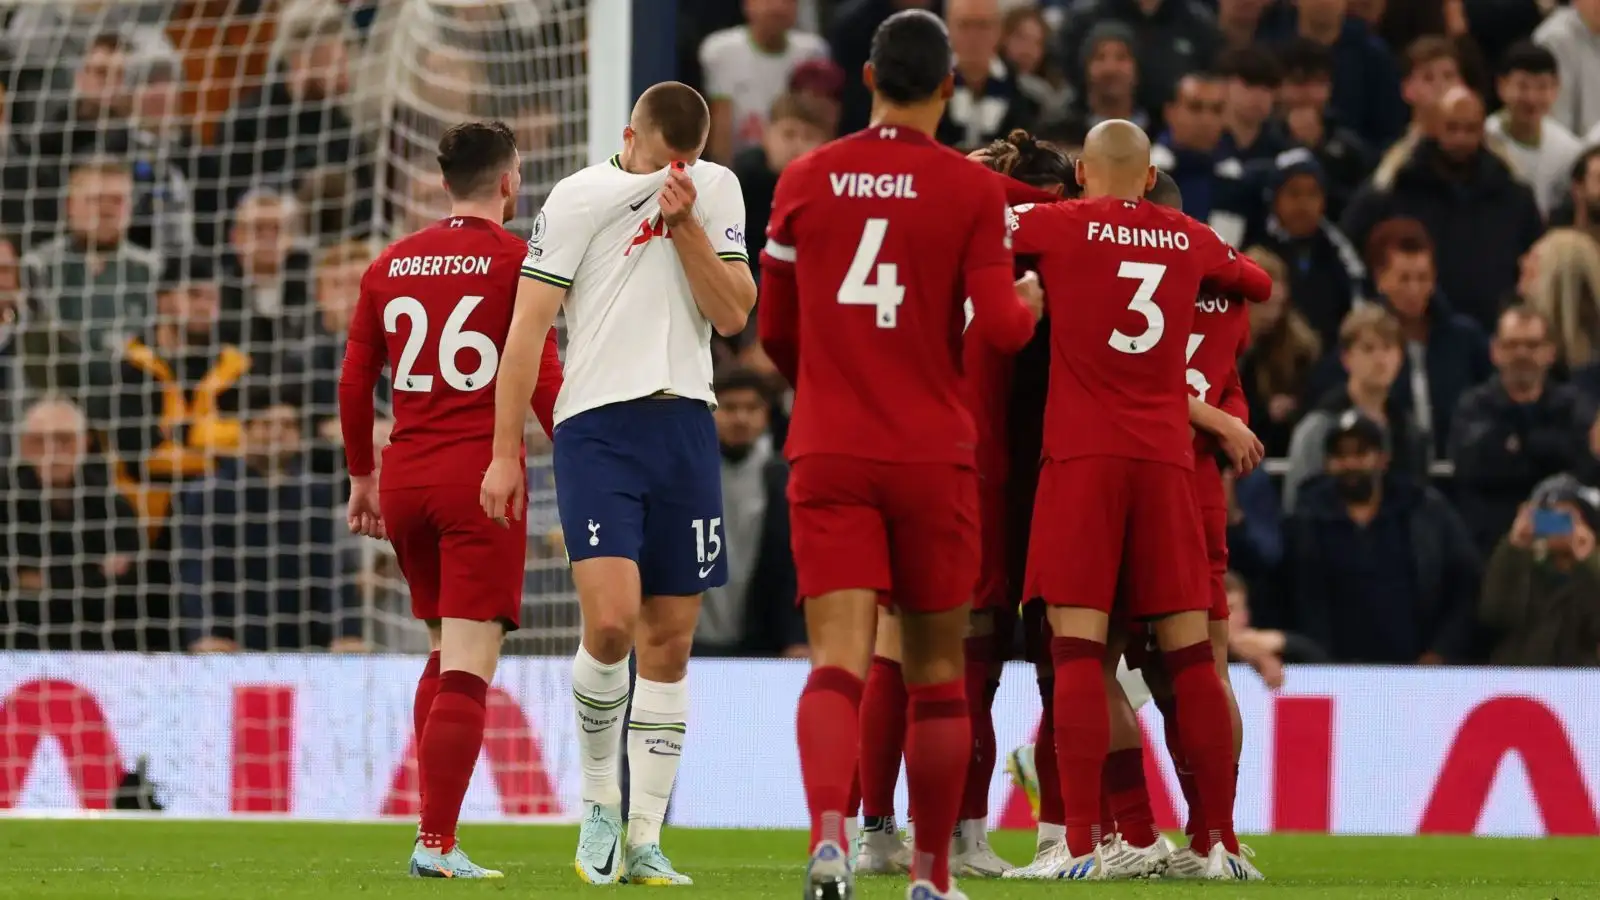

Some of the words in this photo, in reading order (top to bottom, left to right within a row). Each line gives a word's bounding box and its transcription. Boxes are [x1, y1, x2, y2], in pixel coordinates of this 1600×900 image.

[829, 172, 917, 198] VIRGIL
[725, 224, 746, 247] cin
[1087, 221, 1190, 251] FABINHO
[388, 255, 492, 277] ROBERTSON
[837, 218, 906, 328] 4
[1108, 260, 1167, 354] 3
[1195, 298, 1228, 313] GO
[383, 295, 499, 393] 26
[691, 517, 721, 563] 15
[578, 710, 618, 726] SPURS
